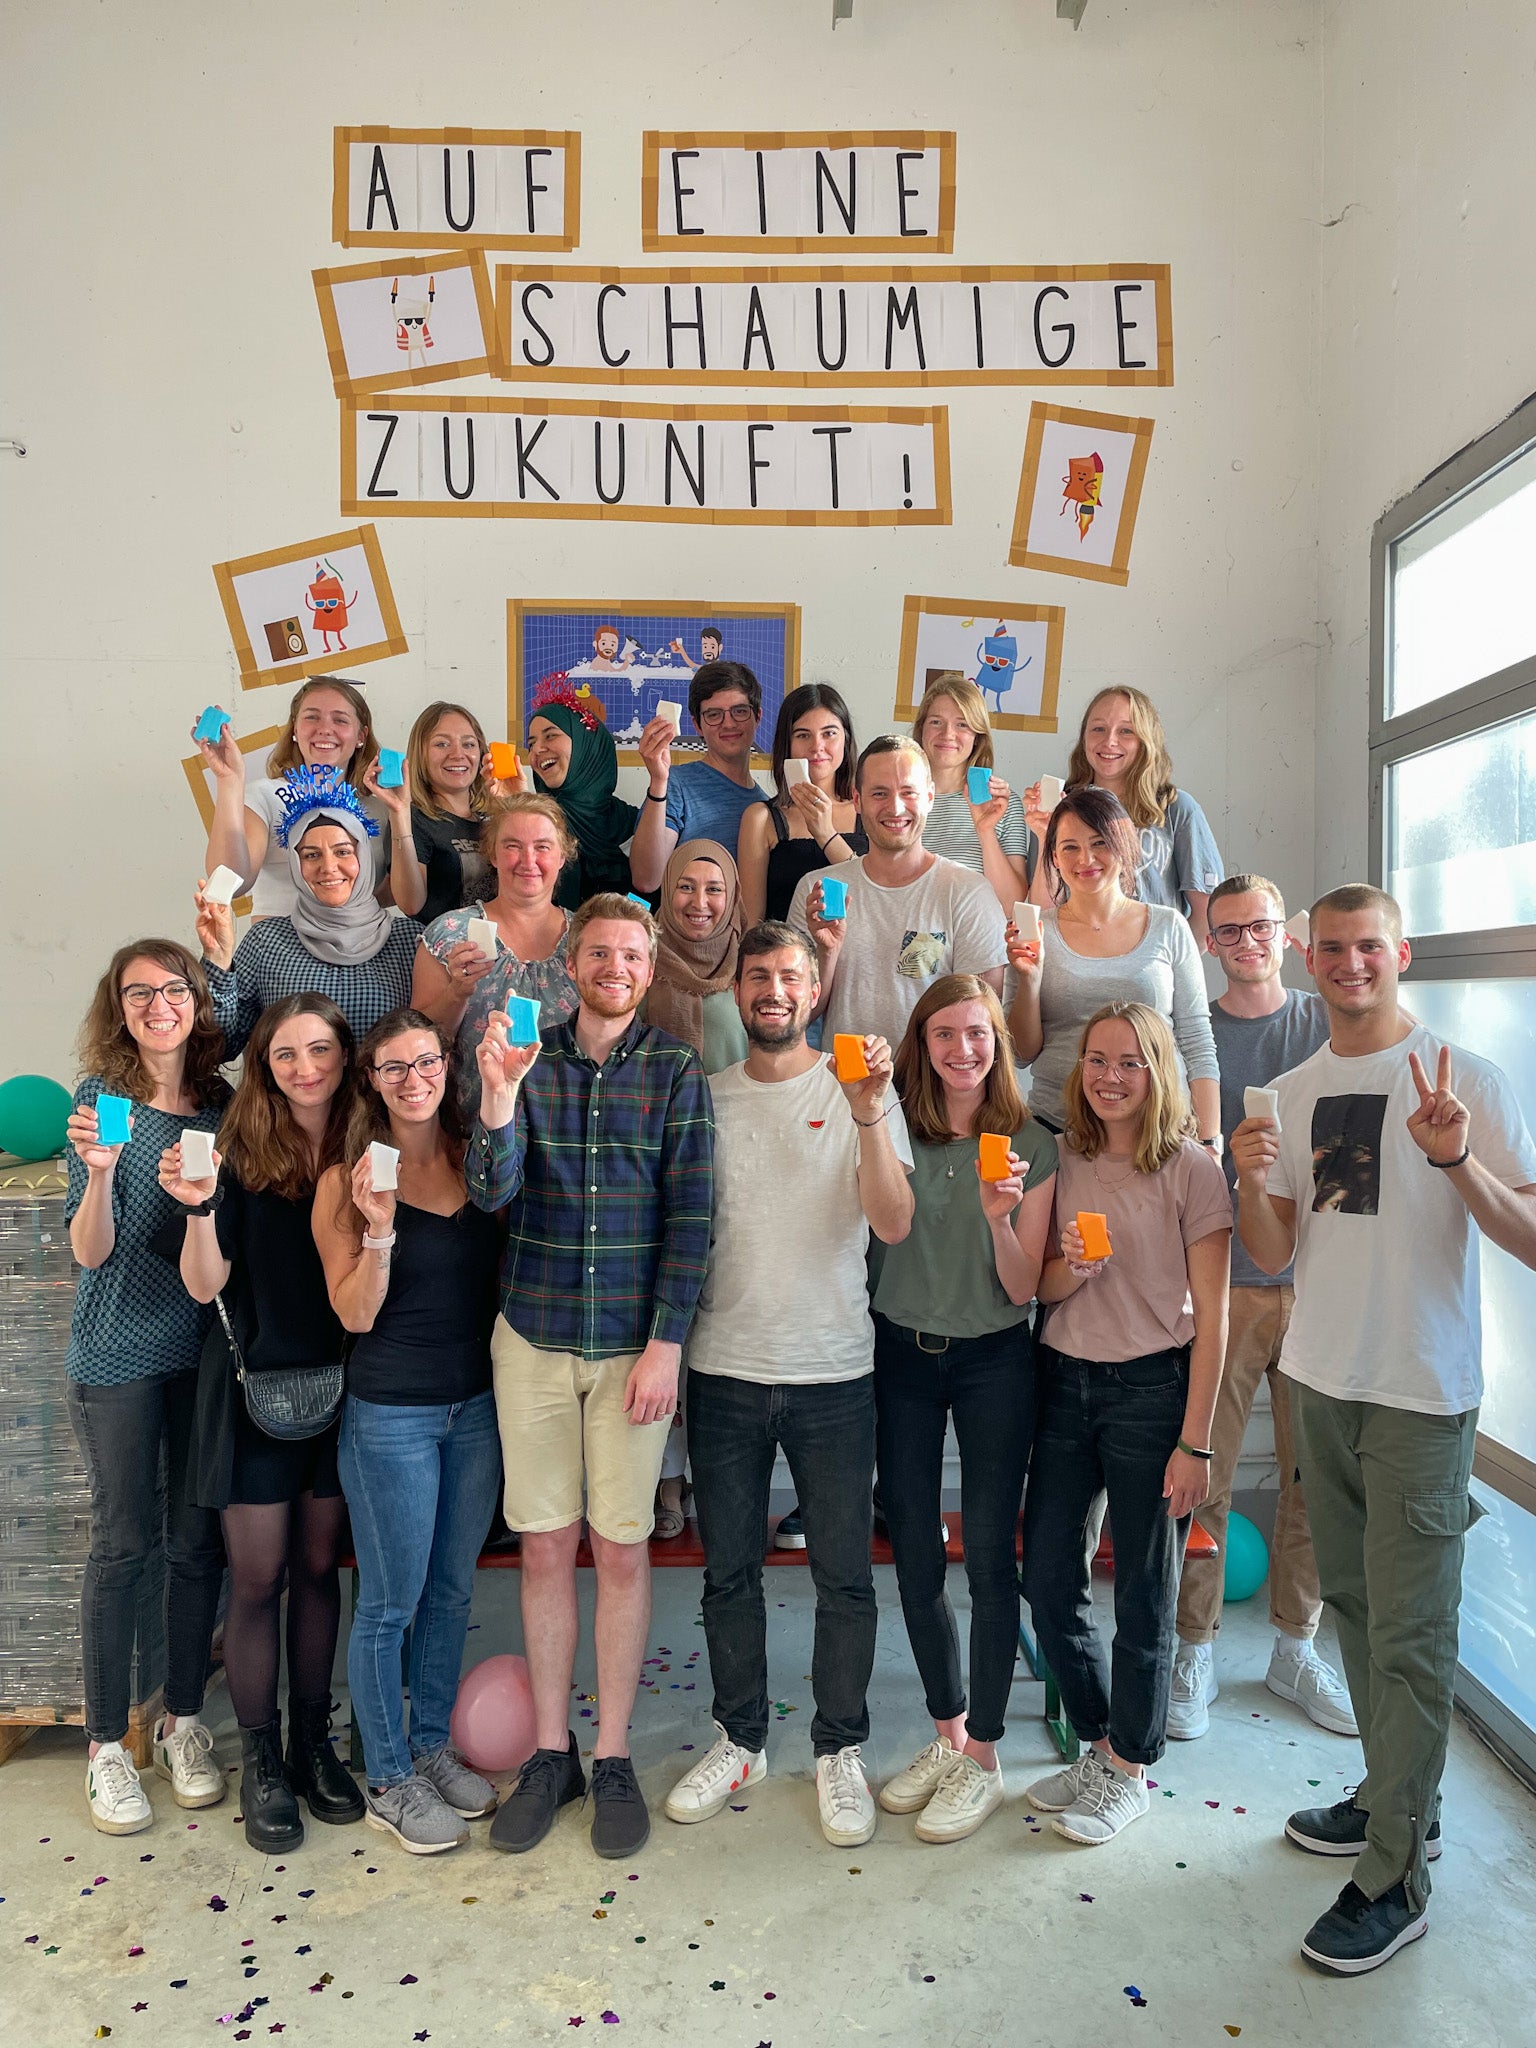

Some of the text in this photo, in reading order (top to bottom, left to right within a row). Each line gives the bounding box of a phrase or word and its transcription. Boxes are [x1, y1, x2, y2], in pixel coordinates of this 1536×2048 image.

[366, 145, 928, 237] AUF EINE
[521, 283, 1147, 371] SCHAUMIGE
[366, 414, 913, 509] ZUKUNFT!
[283, 763, 344, 786] HAPPY
